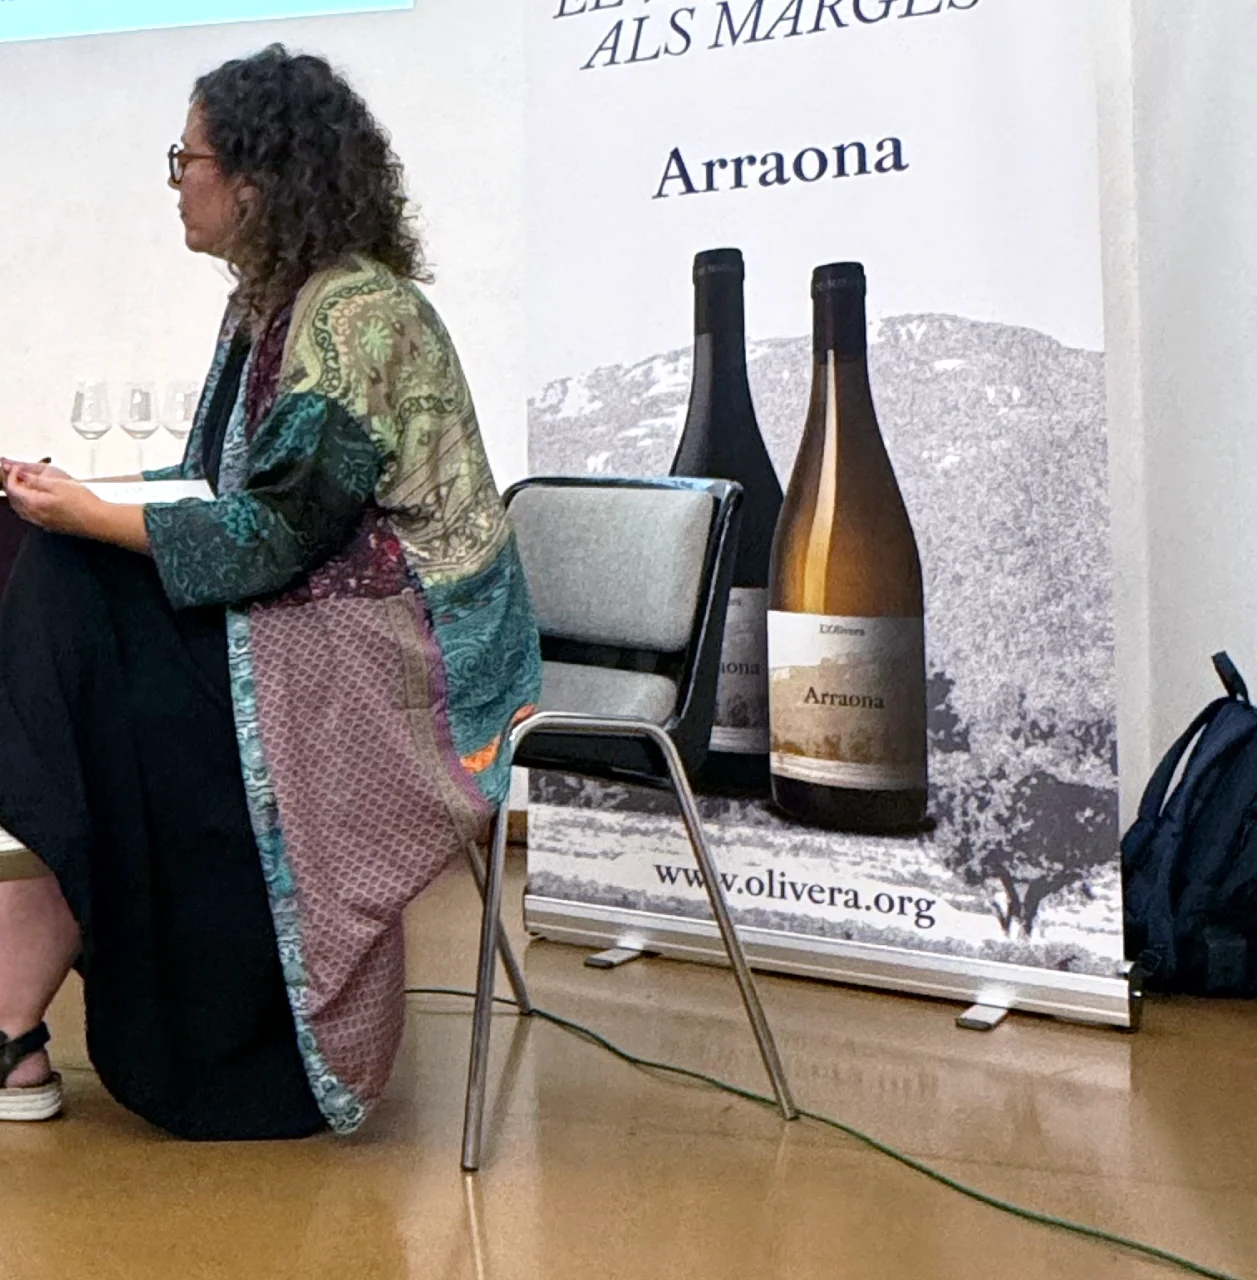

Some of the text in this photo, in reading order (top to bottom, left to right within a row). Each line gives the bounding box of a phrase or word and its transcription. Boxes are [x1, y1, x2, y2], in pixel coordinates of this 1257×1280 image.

[579, 7, 696, 71] ALS
[650, 134, 910, 201] Arraona
[803, 685, 886, 710] Arraona
